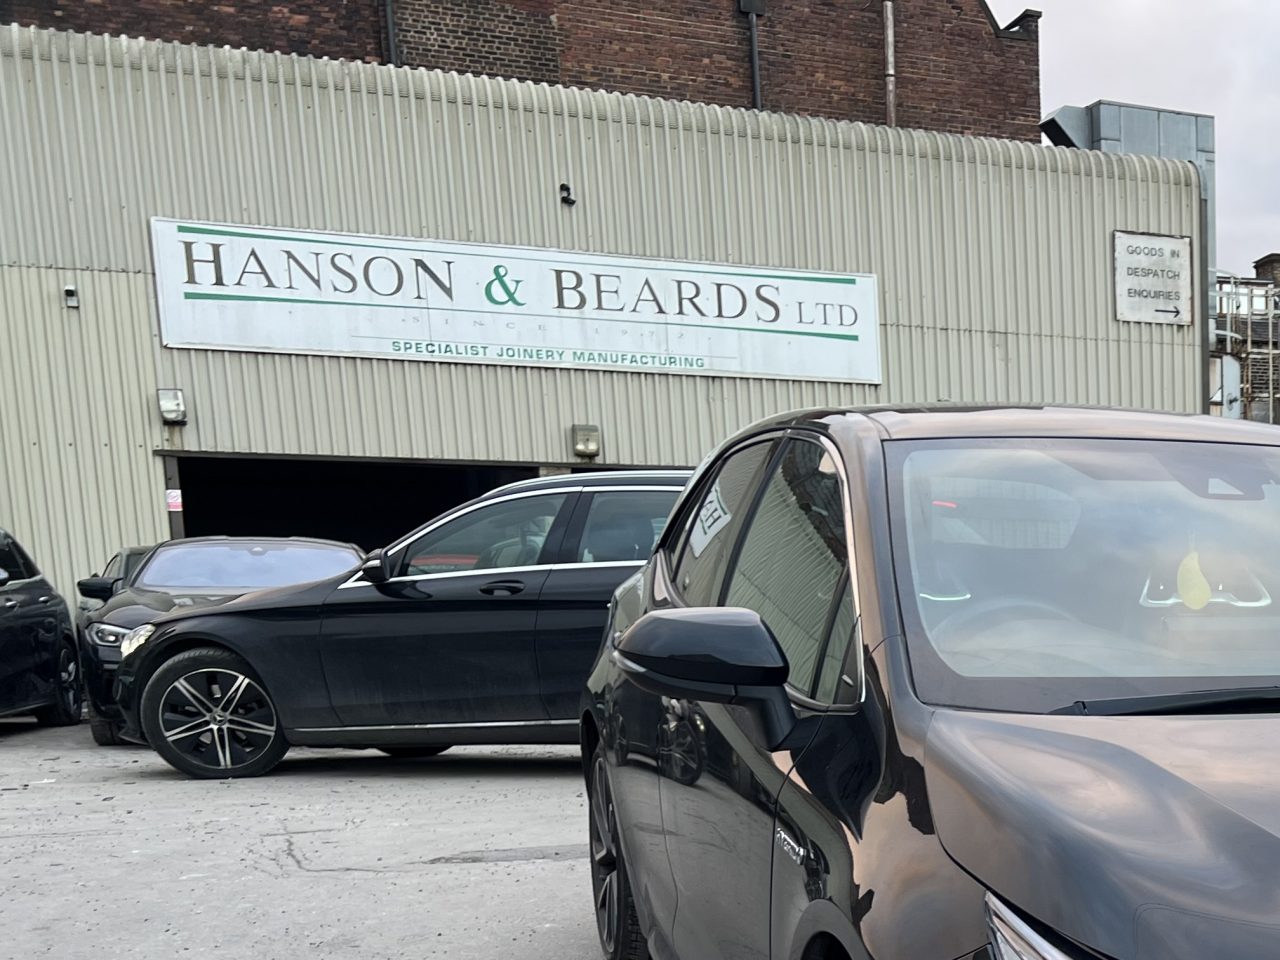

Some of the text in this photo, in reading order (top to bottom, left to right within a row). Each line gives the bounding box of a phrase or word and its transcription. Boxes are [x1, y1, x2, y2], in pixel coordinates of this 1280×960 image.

[1127, 245, 1164, 257] GOODS
[1127, 267, 1180, 280] DESPATCH
[178, 240, 859, 328] HANSON & BEARDS LTD
[1127, 288, 1181, 301] ENQUIRIES
[392, 341, 705, 368] SPECIALIST JOINERY MANUFACTURING
